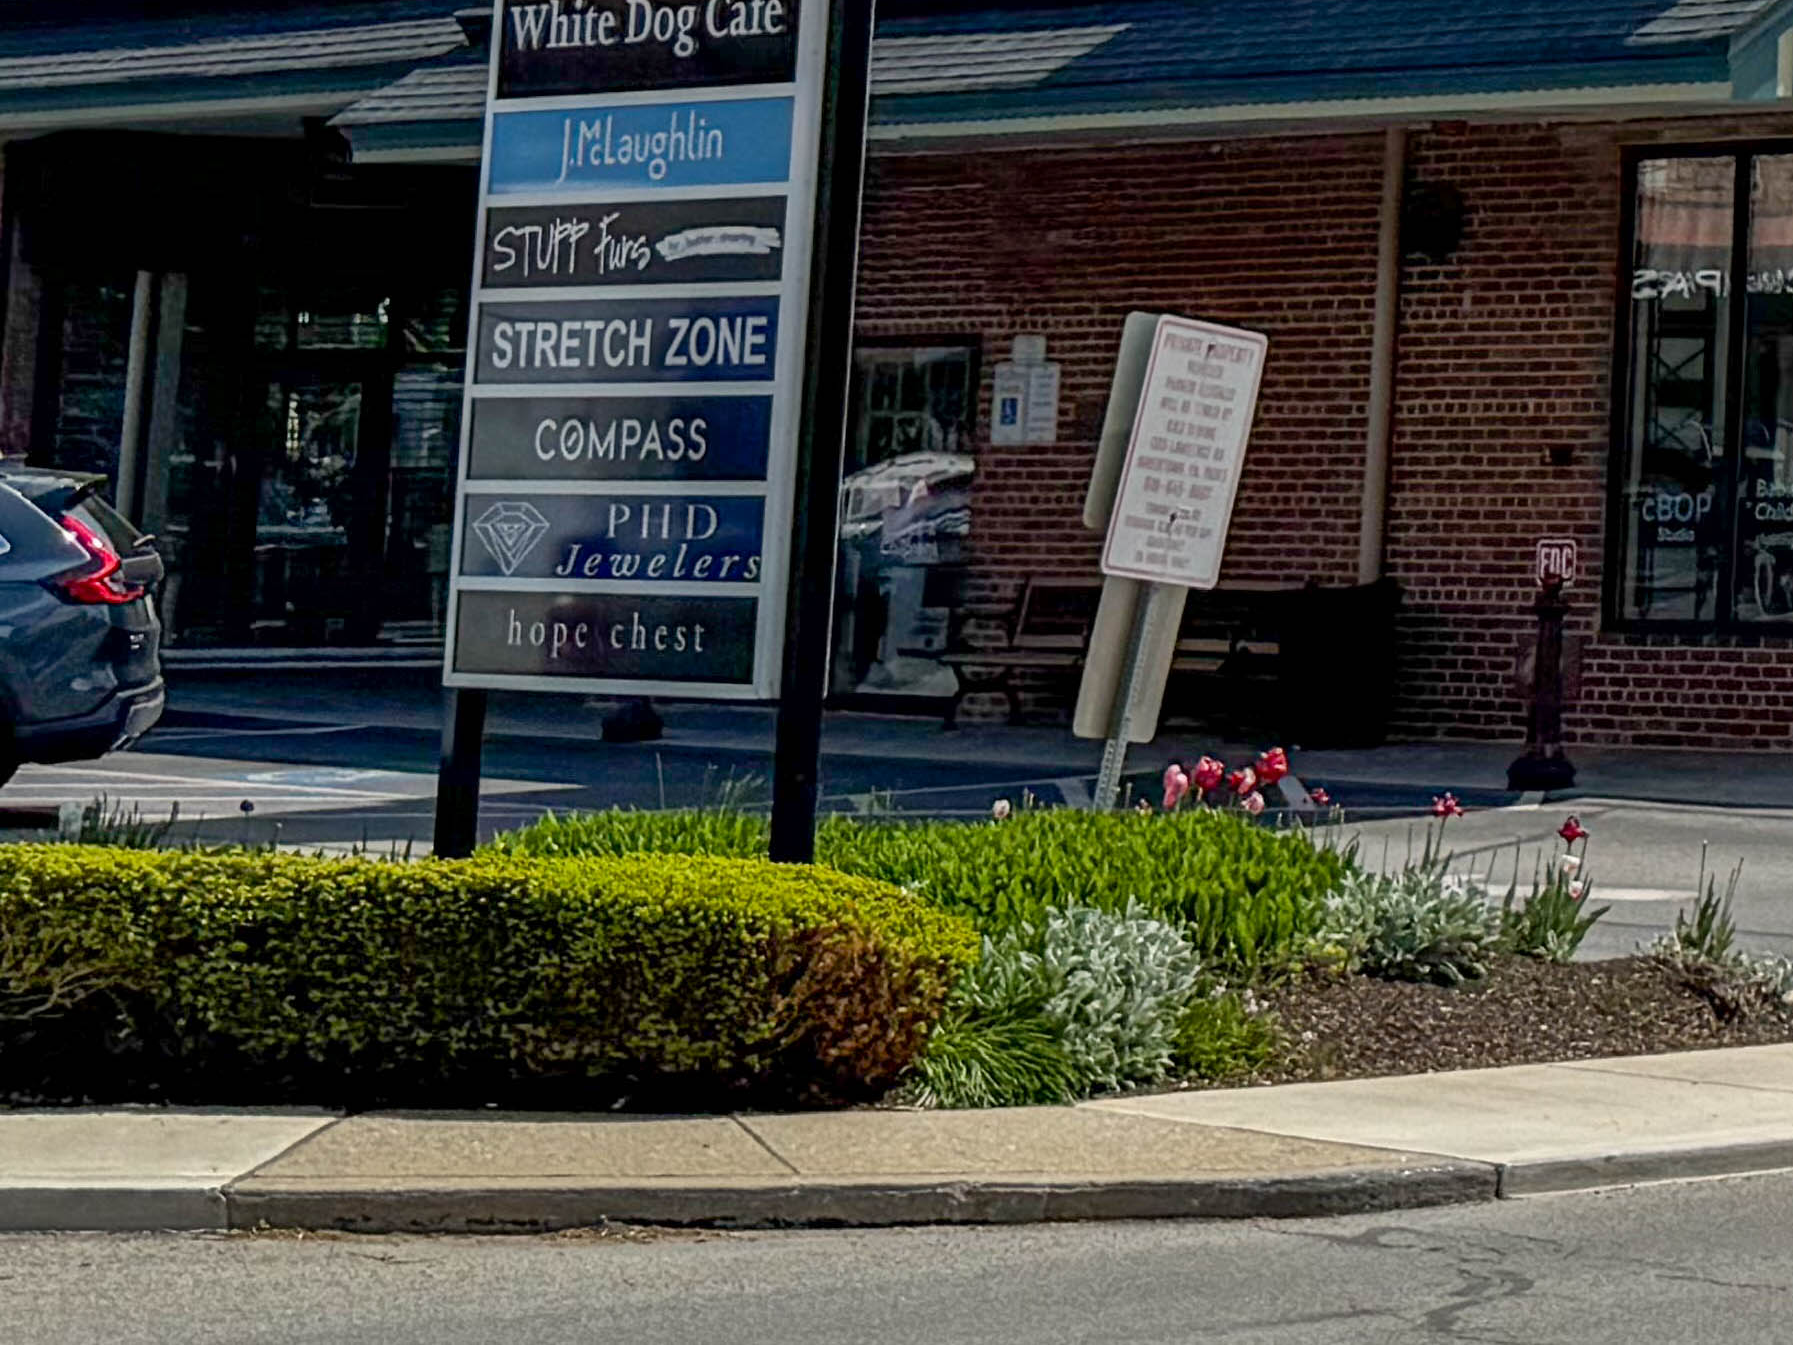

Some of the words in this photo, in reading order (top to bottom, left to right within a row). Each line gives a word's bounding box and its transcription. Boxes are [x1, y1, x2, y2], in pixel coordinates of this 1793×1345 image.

[511, 0, 615, 51] White
[493, 217, 589, 277] STUPP
[594, 212, 652, 275] Furs
[492, 317, 653, 368] STRETCH
[665, 317, 767, 366] ZONE
[534, 418, 707, 460] COMPASS
[556, 544, 762, 580] Jewelers
[507, 609, 588, 657] hope
[610, 612, 705, 652] chest
